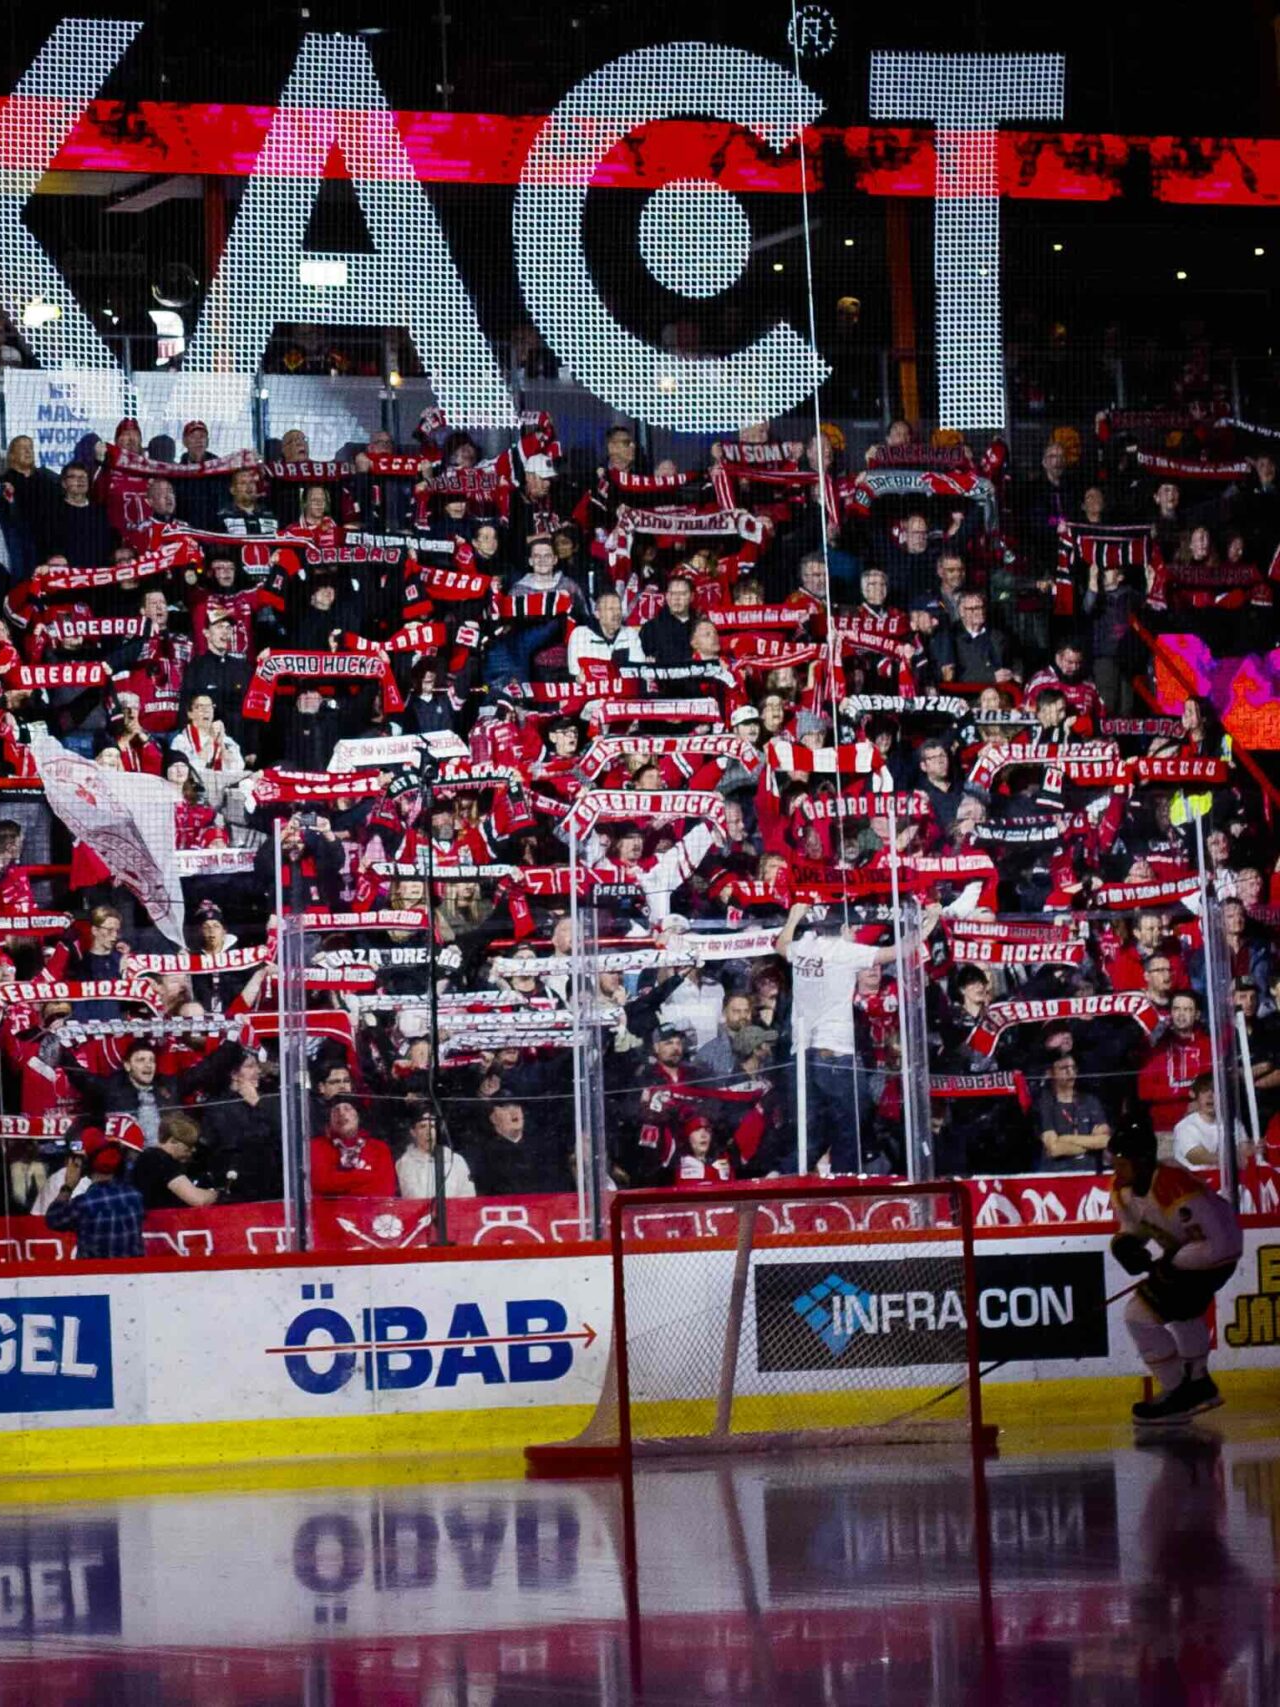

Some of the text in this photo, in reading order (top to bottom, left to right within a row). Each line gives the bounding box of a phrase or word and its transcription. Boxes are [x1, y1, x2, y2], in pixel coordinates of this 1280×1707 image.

[41, 1115, 133, 1139] HOEY
[283, 1282, 575, 1393] ÖBAB
[1225, 1294, 1280, 1346] JA
